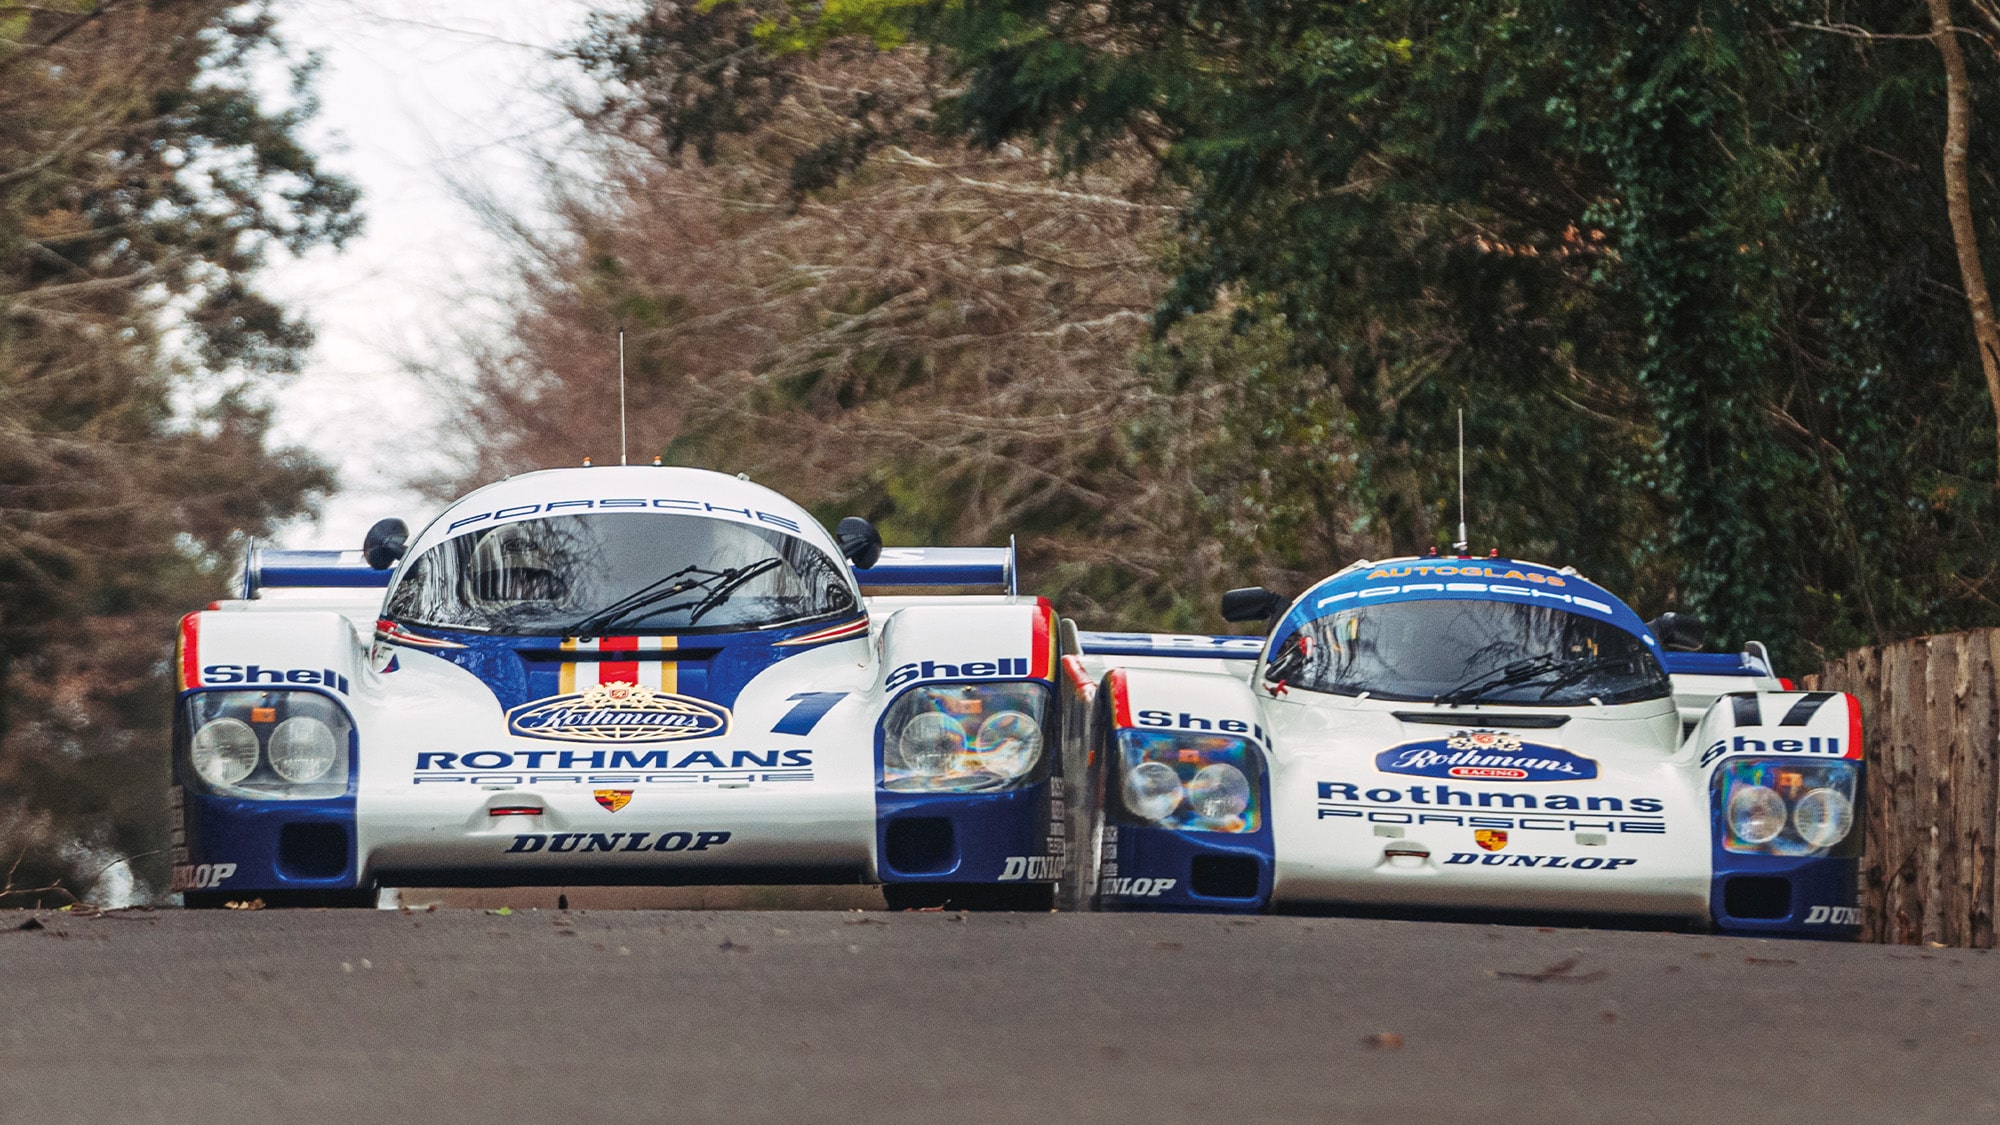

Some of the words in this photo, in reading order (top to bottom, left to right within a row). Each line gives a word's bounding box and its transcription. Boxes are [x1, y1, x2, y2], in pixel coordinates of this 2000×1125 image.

[446, 498, 801, 535] PORSCHE
[1366, 566, 1566, 587] AUTOGLASS
[1317, 583, 1613, 615] PORSCHE
[203, 664, 349, 696] Shell
[885, 658, 1027, 693] Shell
[530, 707, 708, 731] Rothmans
[770, 691, 849, 736] 1
[1716, 691, 1838, 728] 17
[1138, 710, 1273, 754] Shell
[416, 749, 813, 770] ROTHMANS
[1390, 749, 1582, 775] Rothmans
[1700, 735, 1839, 769] Shell
[413, 773, 814, 786] PORSCHE
[1459, 768, 1520, 778] RACING
[1317, 781, 1664, 813] Rothmans
[1317, 809, 1666, 835] PORSCHE
[504, 831, 732, 854] DUNLOP
[1443, 853, 1637, 871] DUNLOP
